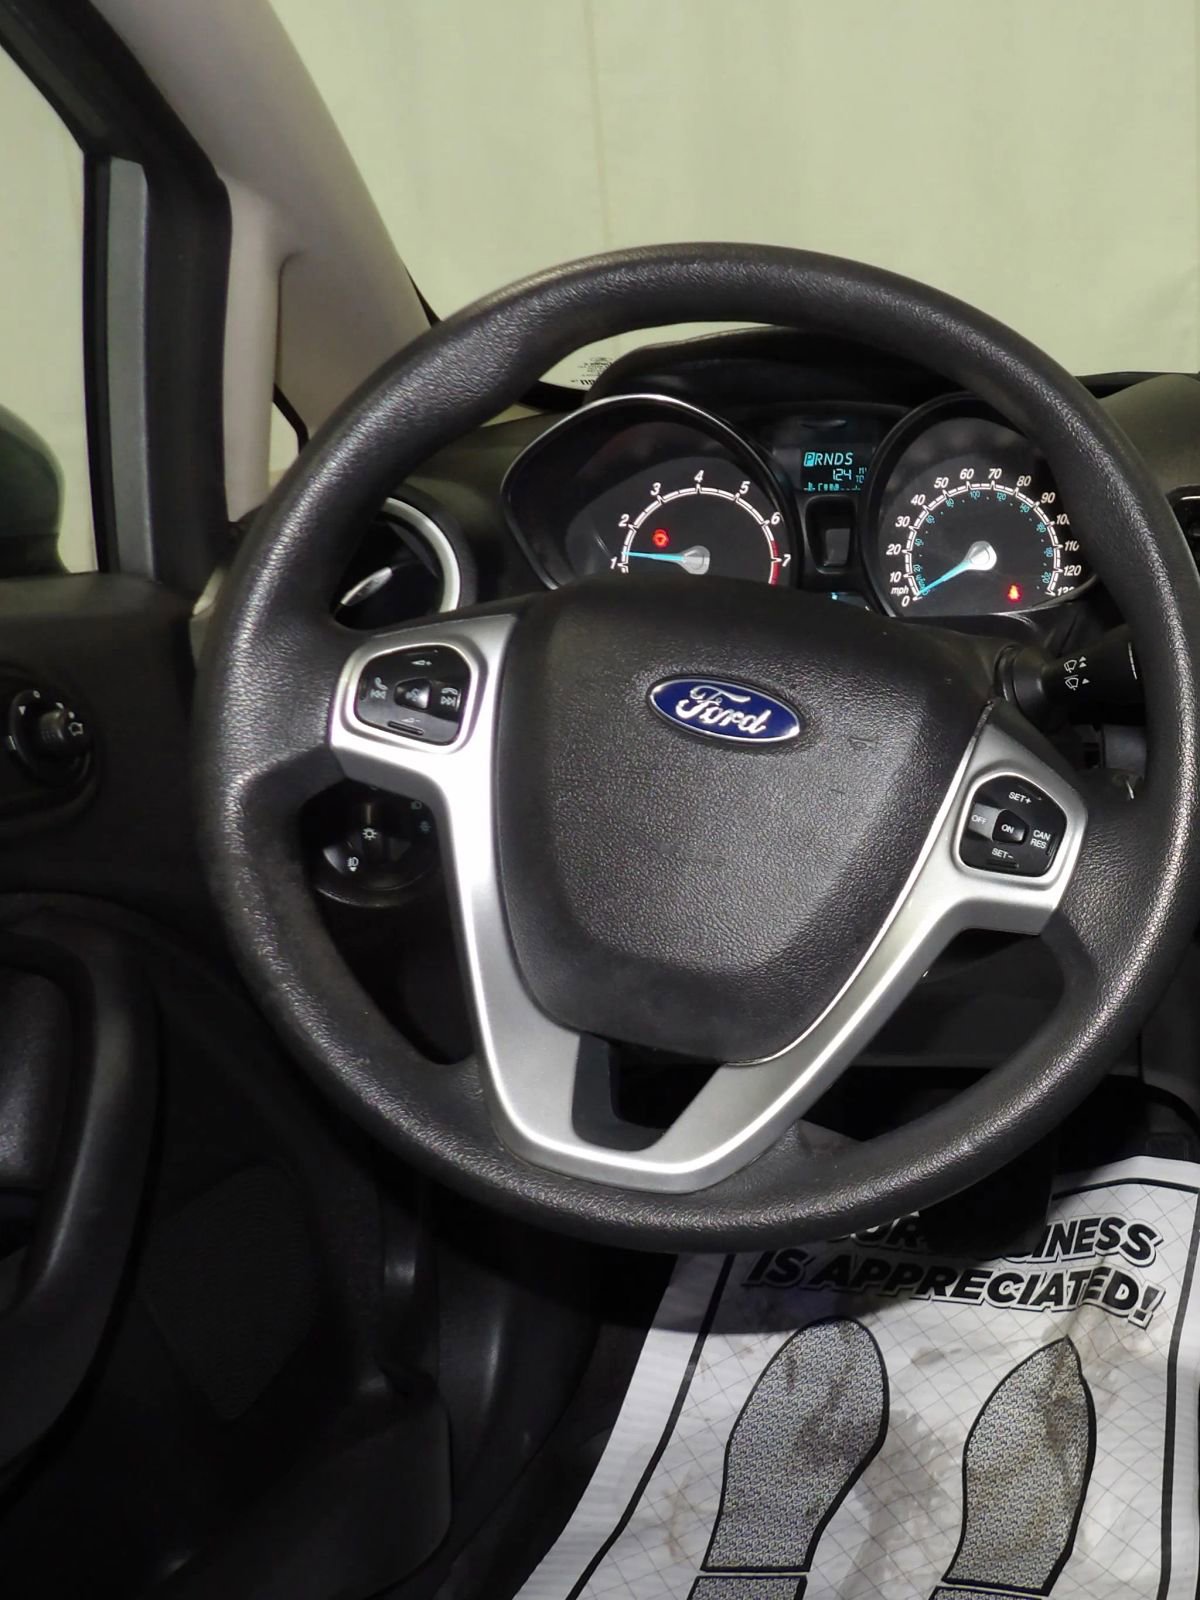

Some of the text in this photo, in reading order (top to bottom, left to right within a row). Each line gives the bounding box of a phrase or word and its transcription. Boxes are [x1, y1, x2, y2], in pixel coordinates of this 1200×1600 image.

[694, 470, 704, 483] 4
[832, 468, 852, 481] 124
[960, 468, 974, 480] 60
[988, 468, 1002, 480] 70
[739, 480, 750, 494] 5
[934, 477, 949, 488] 50
[1016, 476, 1032, 486] 80
[650, 482, 661, 496] 3
[910, 494, 926, 506] 40
[1040, 492, 1056, 504] 90
[618, 514, 630, 527] 2
[770, 512, 780, 525] 6
[895, 516, 910, 528] 30
[886, 544, 902, 556] 20
[610, 557, 617, 570] 1
[782, 554, 792, 567] 7
[1064, 565, 1082, 576] 120
[890, 572, 902, 583] 10
[891, 587, 909, 598] mph
[902, 596, 910, 607] 0
[675, 685, 772, 734] Ford
[971, 814, 987, 824] OFF
[1001, 824, 1014, 834] ON
[1032, 830, 1052, 841] CAN
[1030, 838, 1047, 850] RES
[747, 1248, 1155, 1323] IS APPRECIATED!
